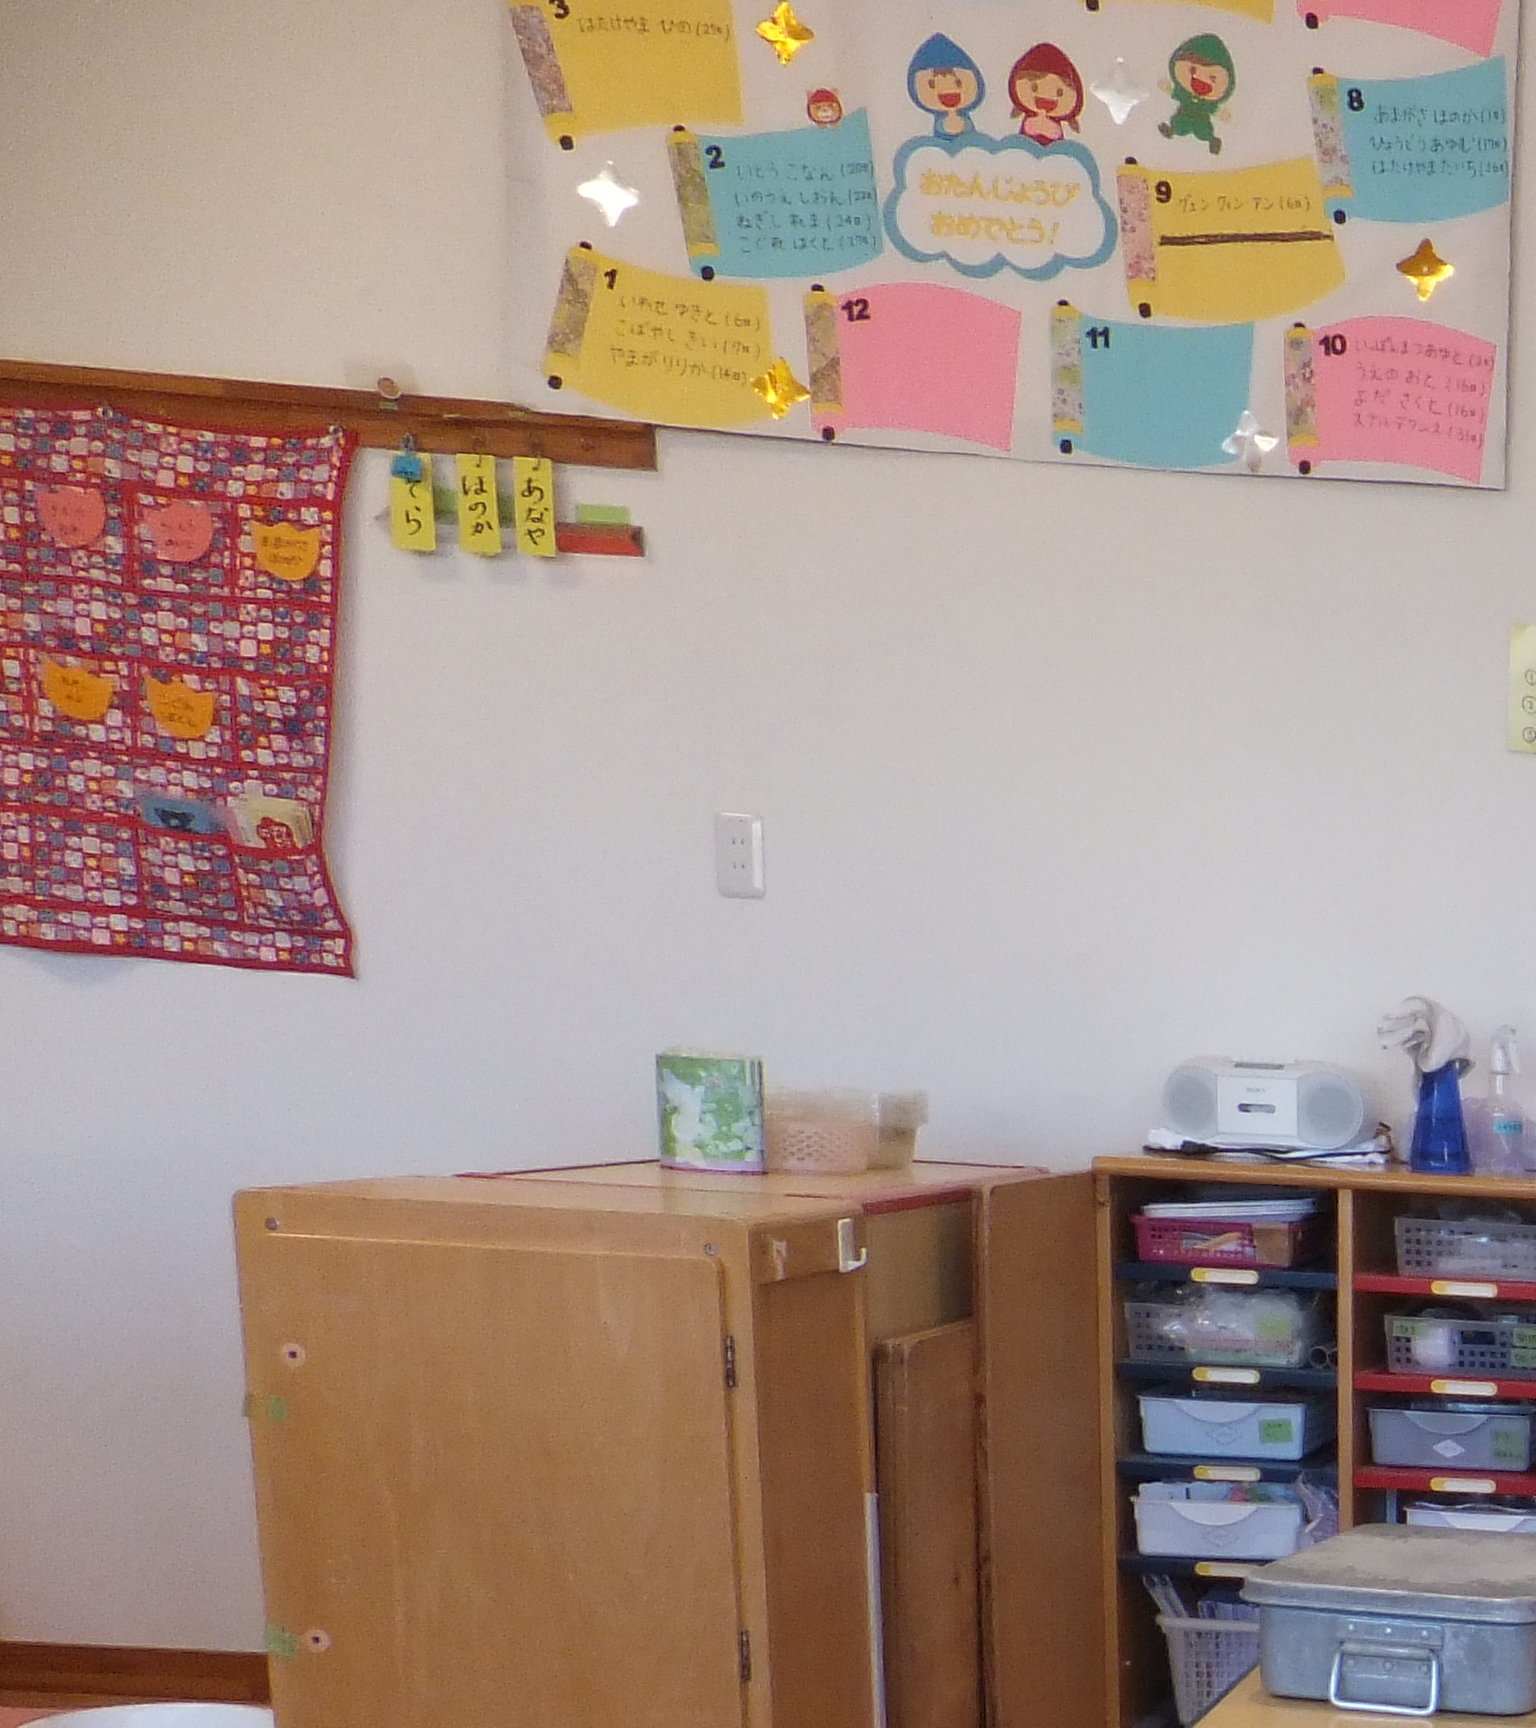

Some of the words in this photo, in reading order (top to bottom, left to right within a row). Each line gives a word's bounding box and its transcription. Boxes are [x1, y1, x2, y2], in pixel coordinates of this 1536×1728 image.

[554, 0, 569, 19] 3
[1347, 88, 1364, 112] 8
[705, 145, 725, 168] 2
[1155, 180, 1172, 203] 9
[604, 270, 617, 289] 1
[842, 299, 870, 322] 12
[1086, 327, 1111, 349] 11
[1319, 334, 1347, 358] 10
